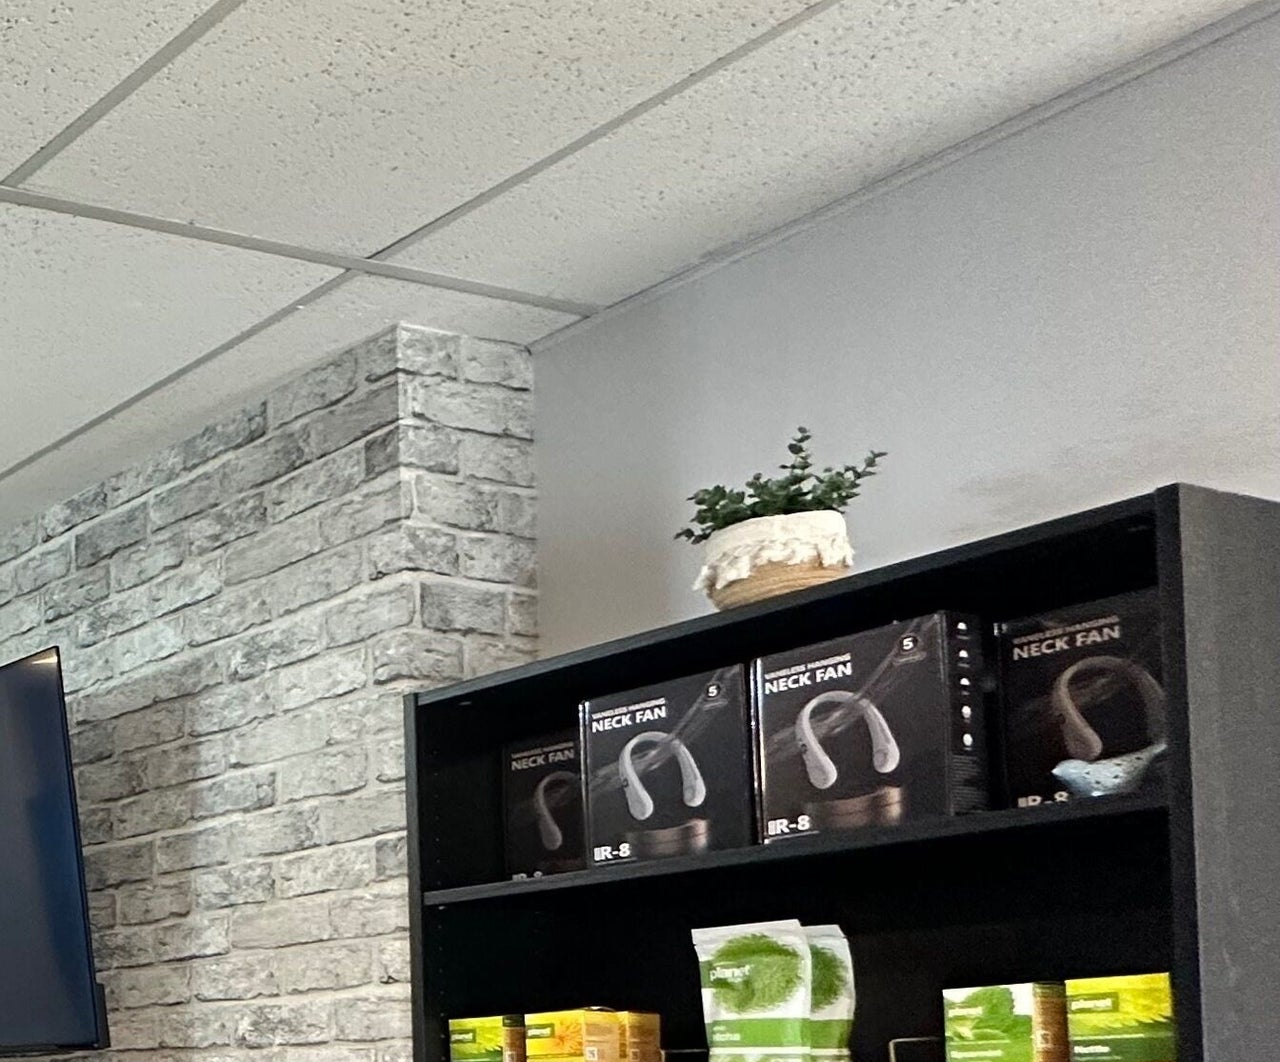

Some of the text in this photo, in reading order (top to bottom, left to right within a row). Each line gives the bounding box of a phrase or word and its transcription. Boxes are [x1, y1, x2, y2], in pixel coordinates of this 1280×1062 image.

[902, 637, 914, 650] 5
[1013, 625, 1121, 661] NECK FAN
[764, 662, 853, 695] NECK FAN
[707, 685, 718, 697] 5
[591, 706, 667, 733] NECK FAN
[511, 754, 546, 771] NECK
[548, 749, 575, 763] FAN
[709, 964, 751, 982] planet
